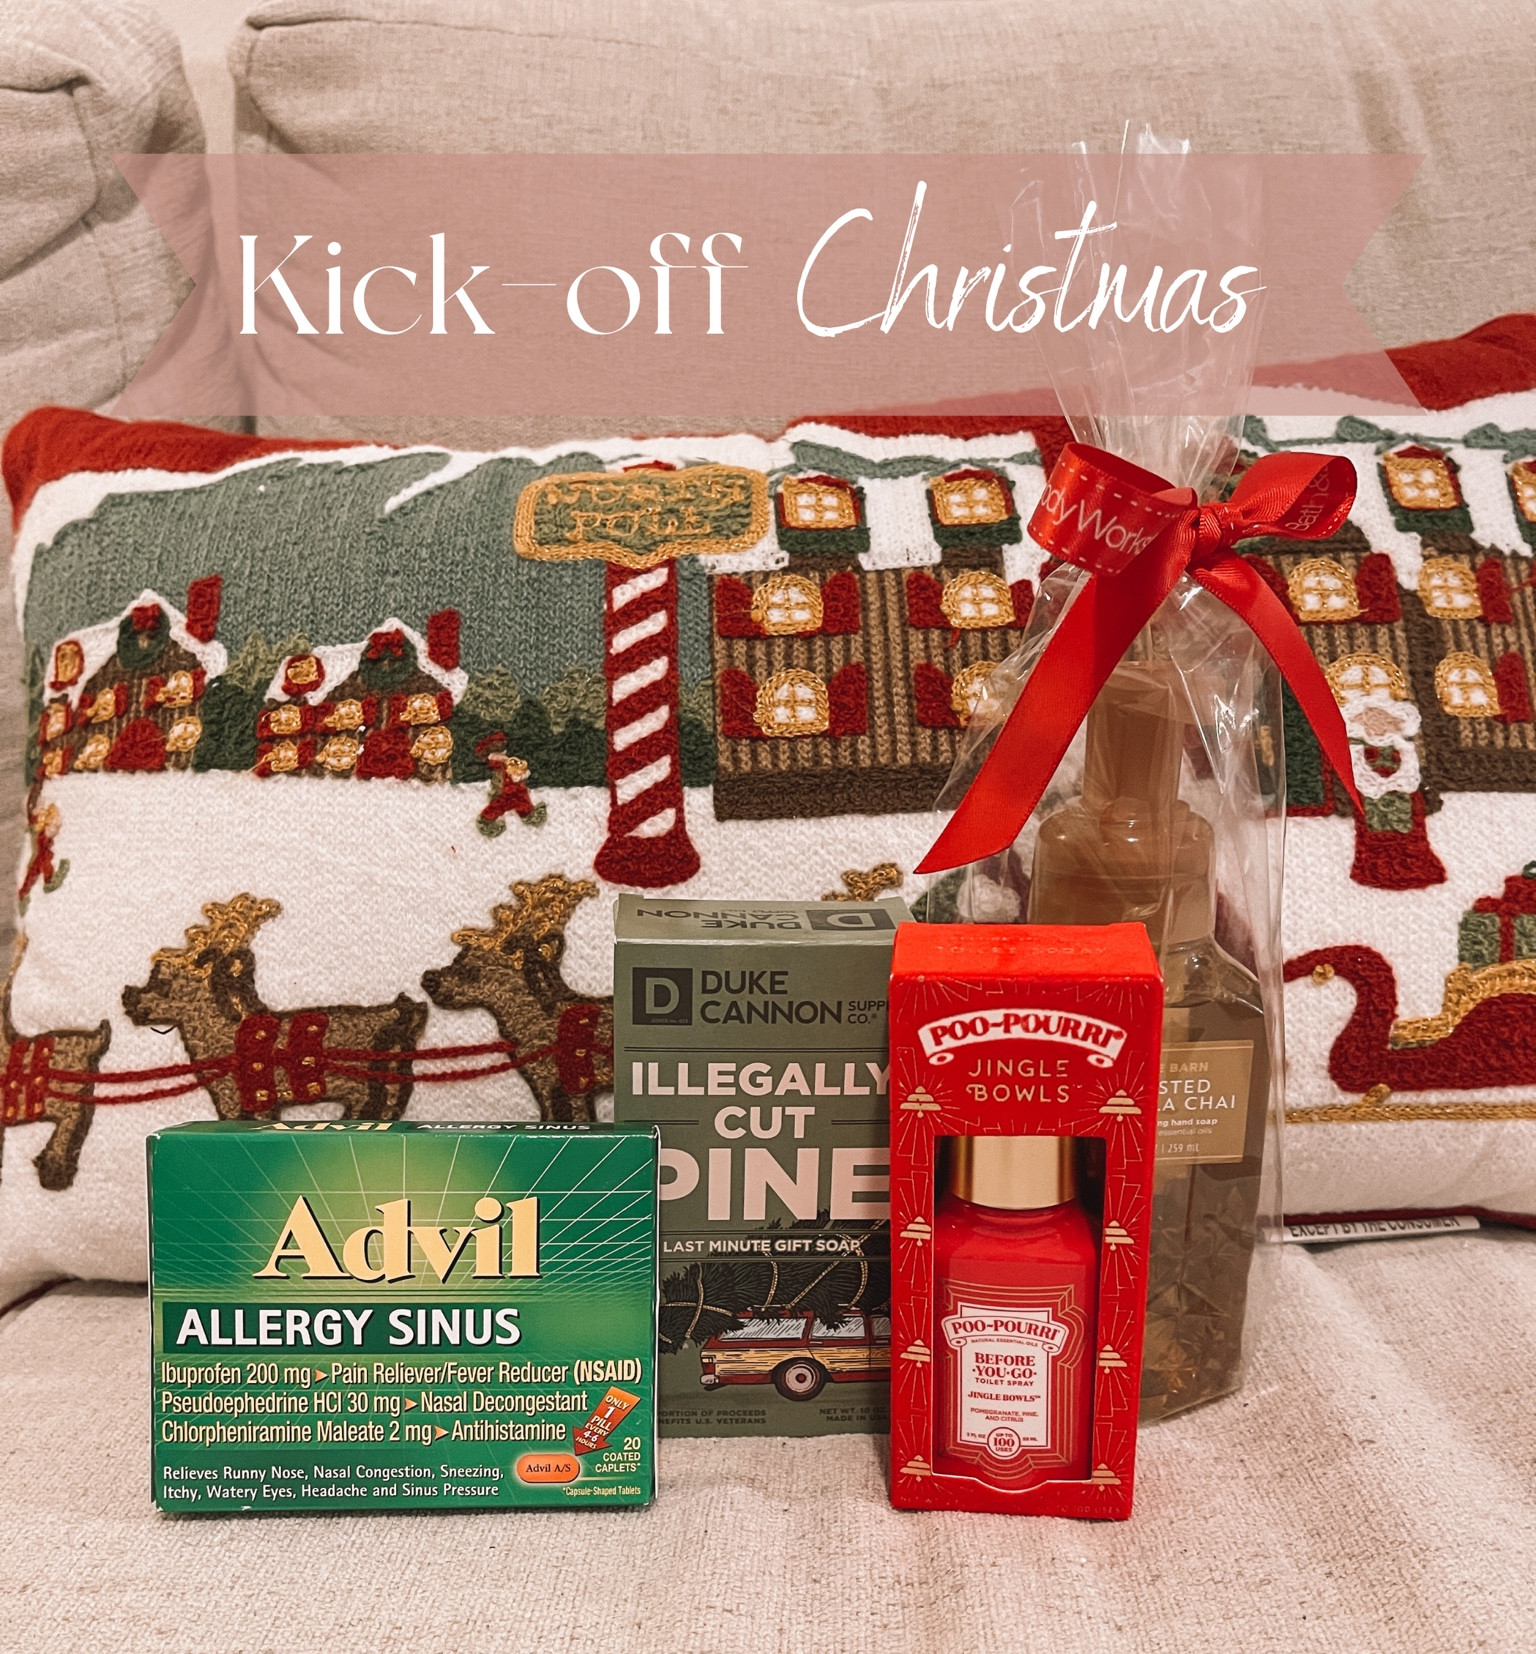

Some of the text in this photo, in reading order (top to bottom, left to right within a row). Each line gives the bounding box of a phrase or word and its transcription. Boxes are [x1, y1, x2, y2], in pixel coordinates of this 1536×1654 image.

[636, 908, 800, 922] CANNON
[700, 919, 803, 931] DUKE
[700, 970, 789, 995] DUKE
[645, 976, 680, 1015] D
[700, 1000, 843, 1025] CANNON
[968, 1058, 1070, 1078] JINGLE
[1169, 1061, 1210, 1073] BARN
[631, 1061, 890, 1097] ILLEGALLY
[1184, 1094, 1236, 1111] CHAI
[250, 1121, 395, 1132] Advil
[416, 1123, 518, 1131] ALLERGY
[713, 1105, 816, 1140] CUT
[1170, 1117, 1194, 1126] hand
[1196, 1118, 1218, 1126] soap
[1167, 1143, 1185, 1153] 259
[658, 1147, 891, 1221] PINE
[252, 1194, 544, 1286] Advil
[662, 1239, 861, 1253] LAST MINUTE GIFT SOAP
[175, 1307, 522, 1347] ALLERGY SINUS
[974, 1351, 1036, 1367] BEFORE
[161, 1357, 643, 1389] Ibuprofen 200 mg Pain Reliever/Fever Reducer (NSAID)
[975, 1377, 1005, 1386] TOILET
[605, 1394, 630, 1411] ONLY
[967, 1390, 1001, 1401] JINGLE
[161, 1390, 309, 1419] Pseudoephedrine
[347, 1391, 369, 1414] 30
[373, 1394, 401, 1418] mg
[421, 1391, 468, 1413] Nasal
[473, 1390, 588, 1417] Decongestant
[819, 1407, 838, 1415] NET
[603, 1406, 616, 1419] 1
[701, 1409, 714, 1417] OF
[717, 1409, 767, 1417] PROCEEDS
[970, 1407, 1021, 1417] POMEGRANATE,
[590, 1415, 612, 1432] PILL
[717, 1417, 767, 1425] VETERANS
[161, 1418, 567, 1448] Chlorpheniramine Maleate 2 mg Antihistamine
[583, 1430, 600, 1443] 4-6
[584, 1422, 609, 1437] EVERY
[575, 1436, 597, 1450] HOURS
[622, 1436, 641, 1450] 20
[993, 1437, 1015, 1447] 100
[602, 1452, 641, 1462] COATED
[163, 1463, 505, 1483] Relieves Runny Nose, Nasal Congestion, Sneezing,
[525, 1462, 571, 1473] Advil A/S
[163, 1482, 500, 1502] Itchy, Watery Eyes, Headache and Sinus Pressure
[618, 1485, 642, 1496] Tablets
